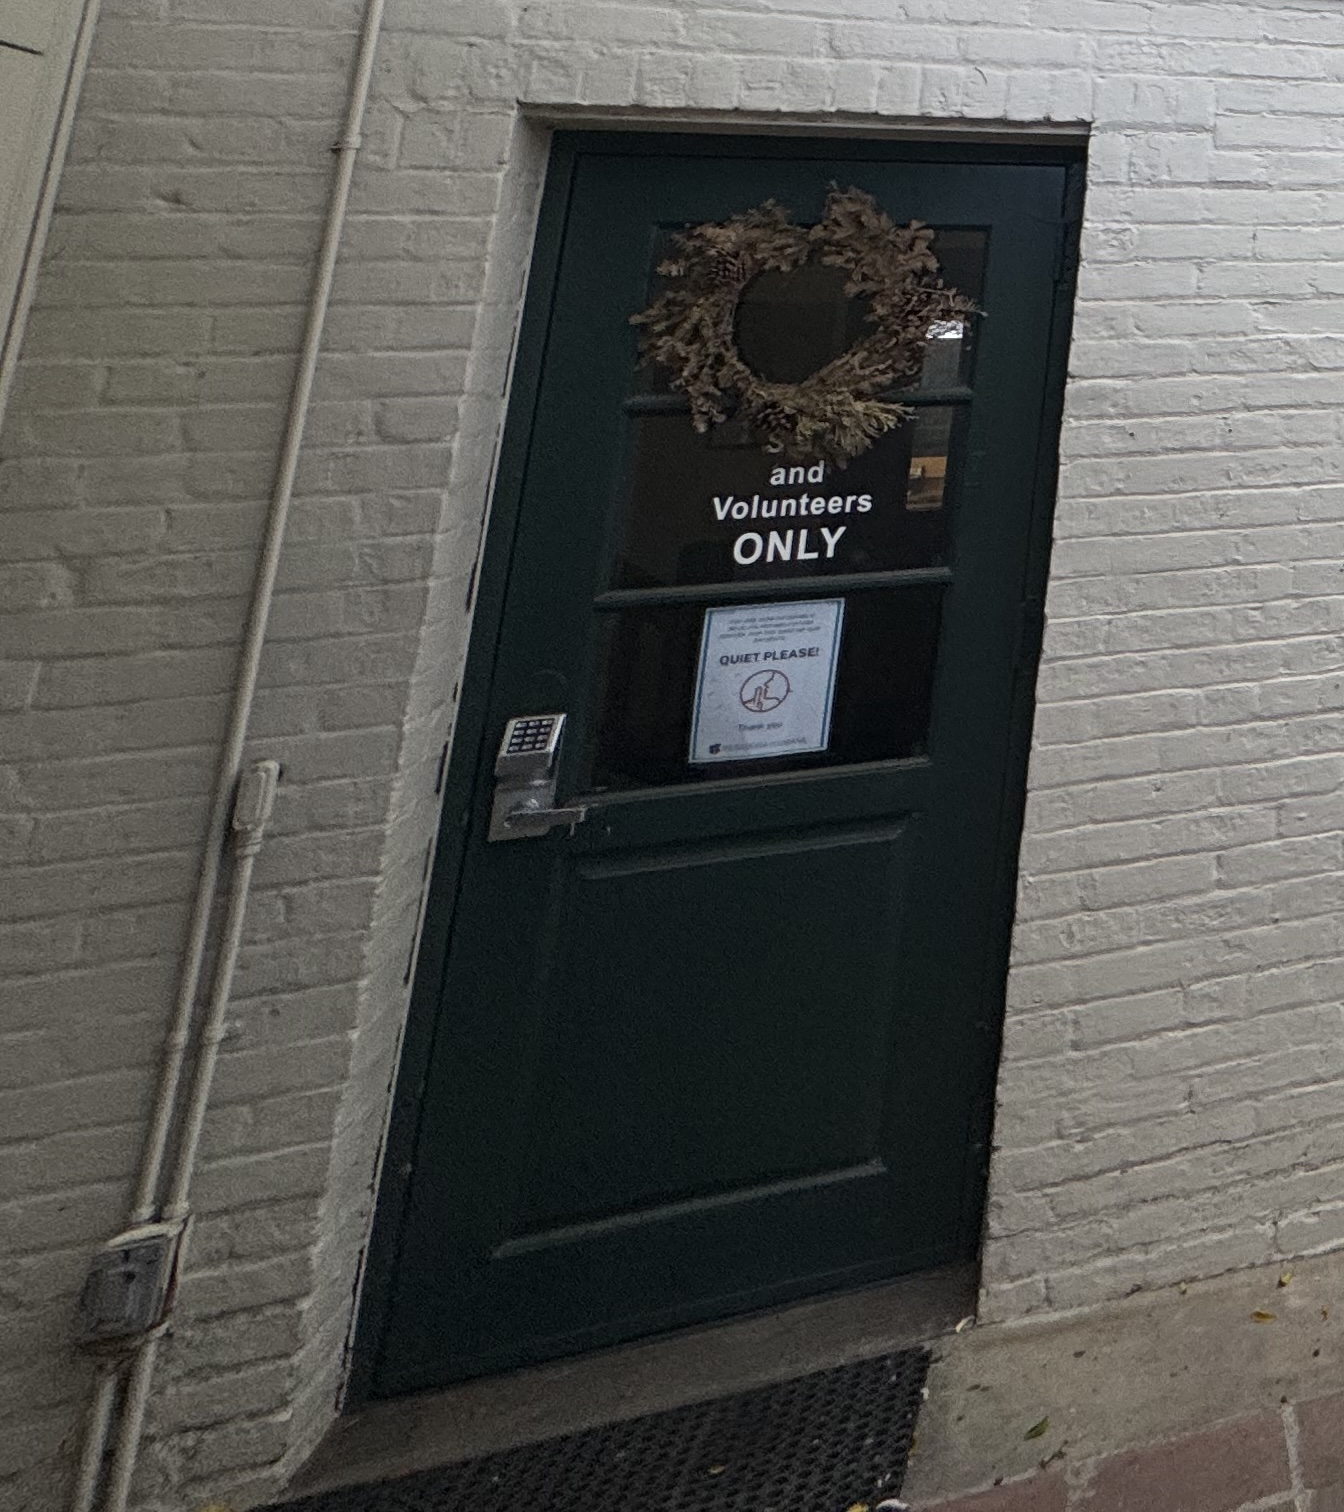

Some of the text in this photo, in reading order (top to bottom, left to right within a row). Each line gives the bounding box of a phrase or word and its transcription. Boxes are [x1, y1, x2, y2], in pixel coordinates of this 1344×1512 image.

[769, 460, 825, 486] and
[712, 493, 873, 521] Volunteers
[733, 526, 847, 565] ONLY
[719, 646, 820, 666] QUIET PLEASE!
